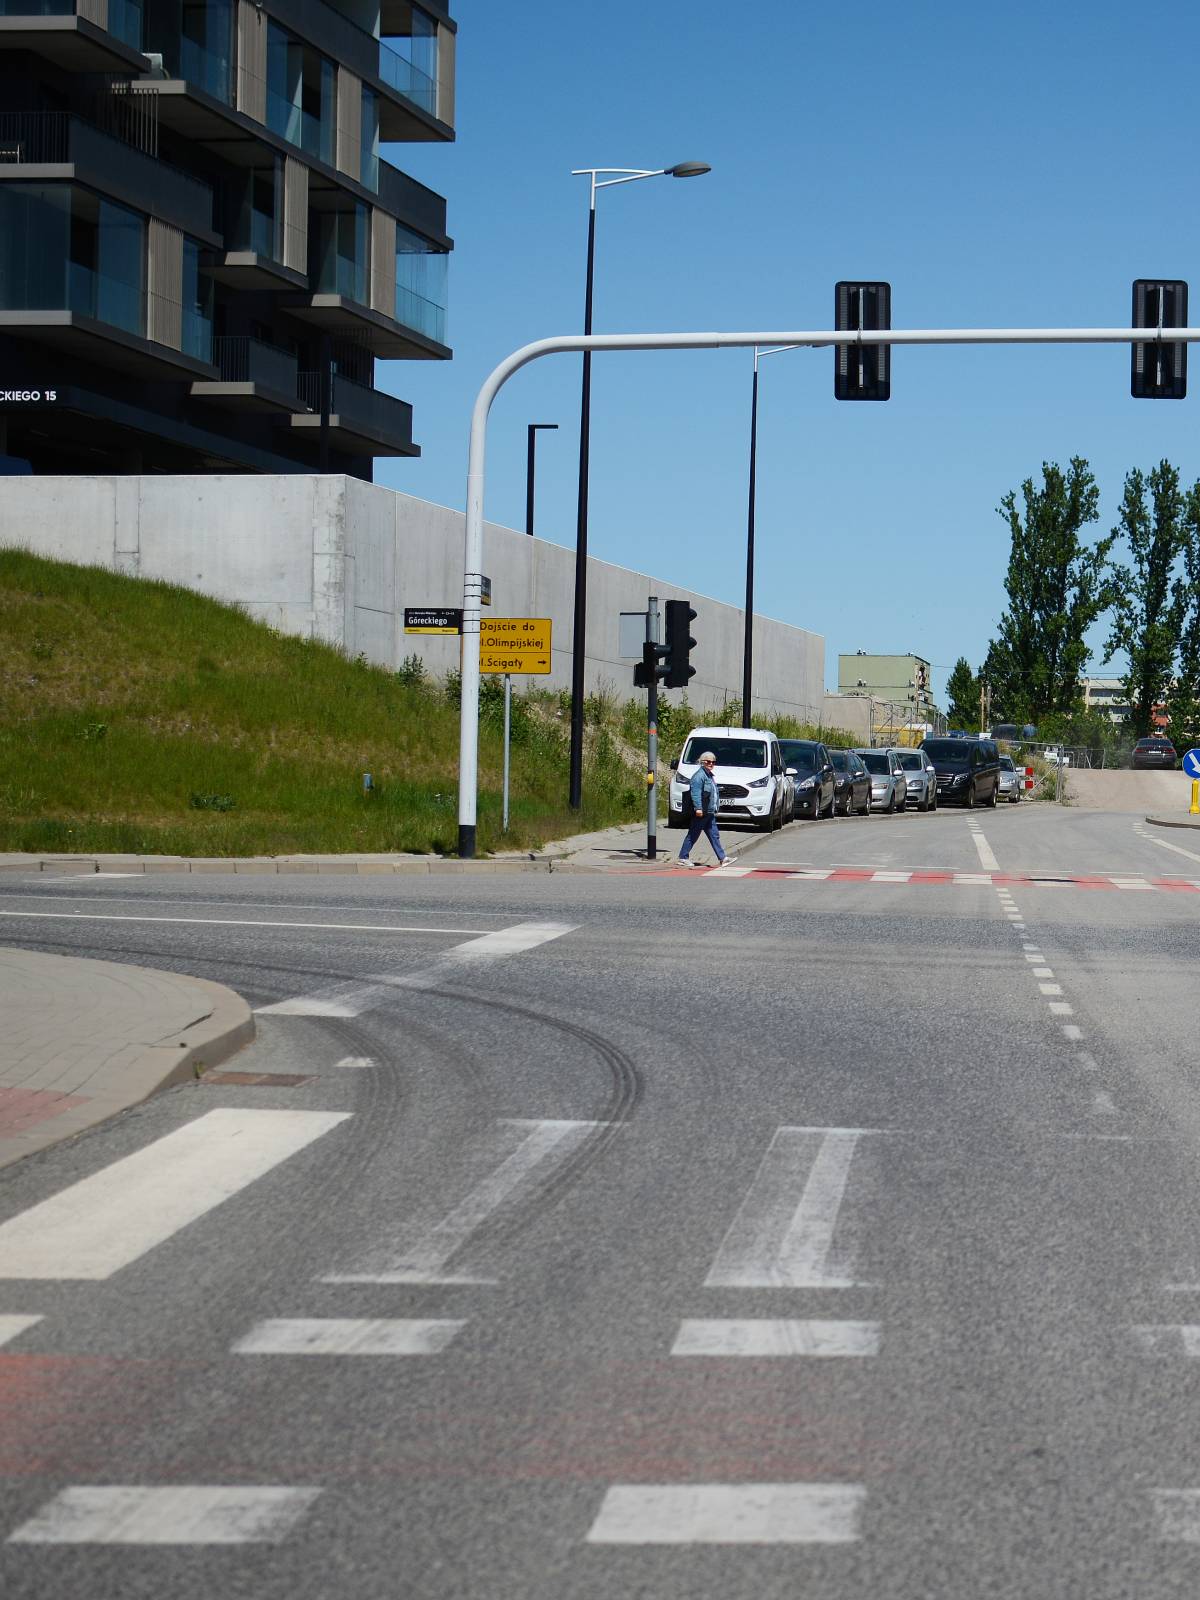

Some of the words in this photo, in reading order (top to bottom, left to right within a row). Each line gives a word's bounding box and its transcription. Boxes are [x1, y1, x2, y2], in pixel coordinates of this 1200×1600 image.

[44, 391, 57, 401] 15
[408, 616, 448, 626] Góreckiego
[480, 622, 517, 632] Dojście
[523, 622, 535, 631] do
[480, 638, 544, 649] l.Olimpijskiej
[480, 656, 523, 669] l.Ścigały
